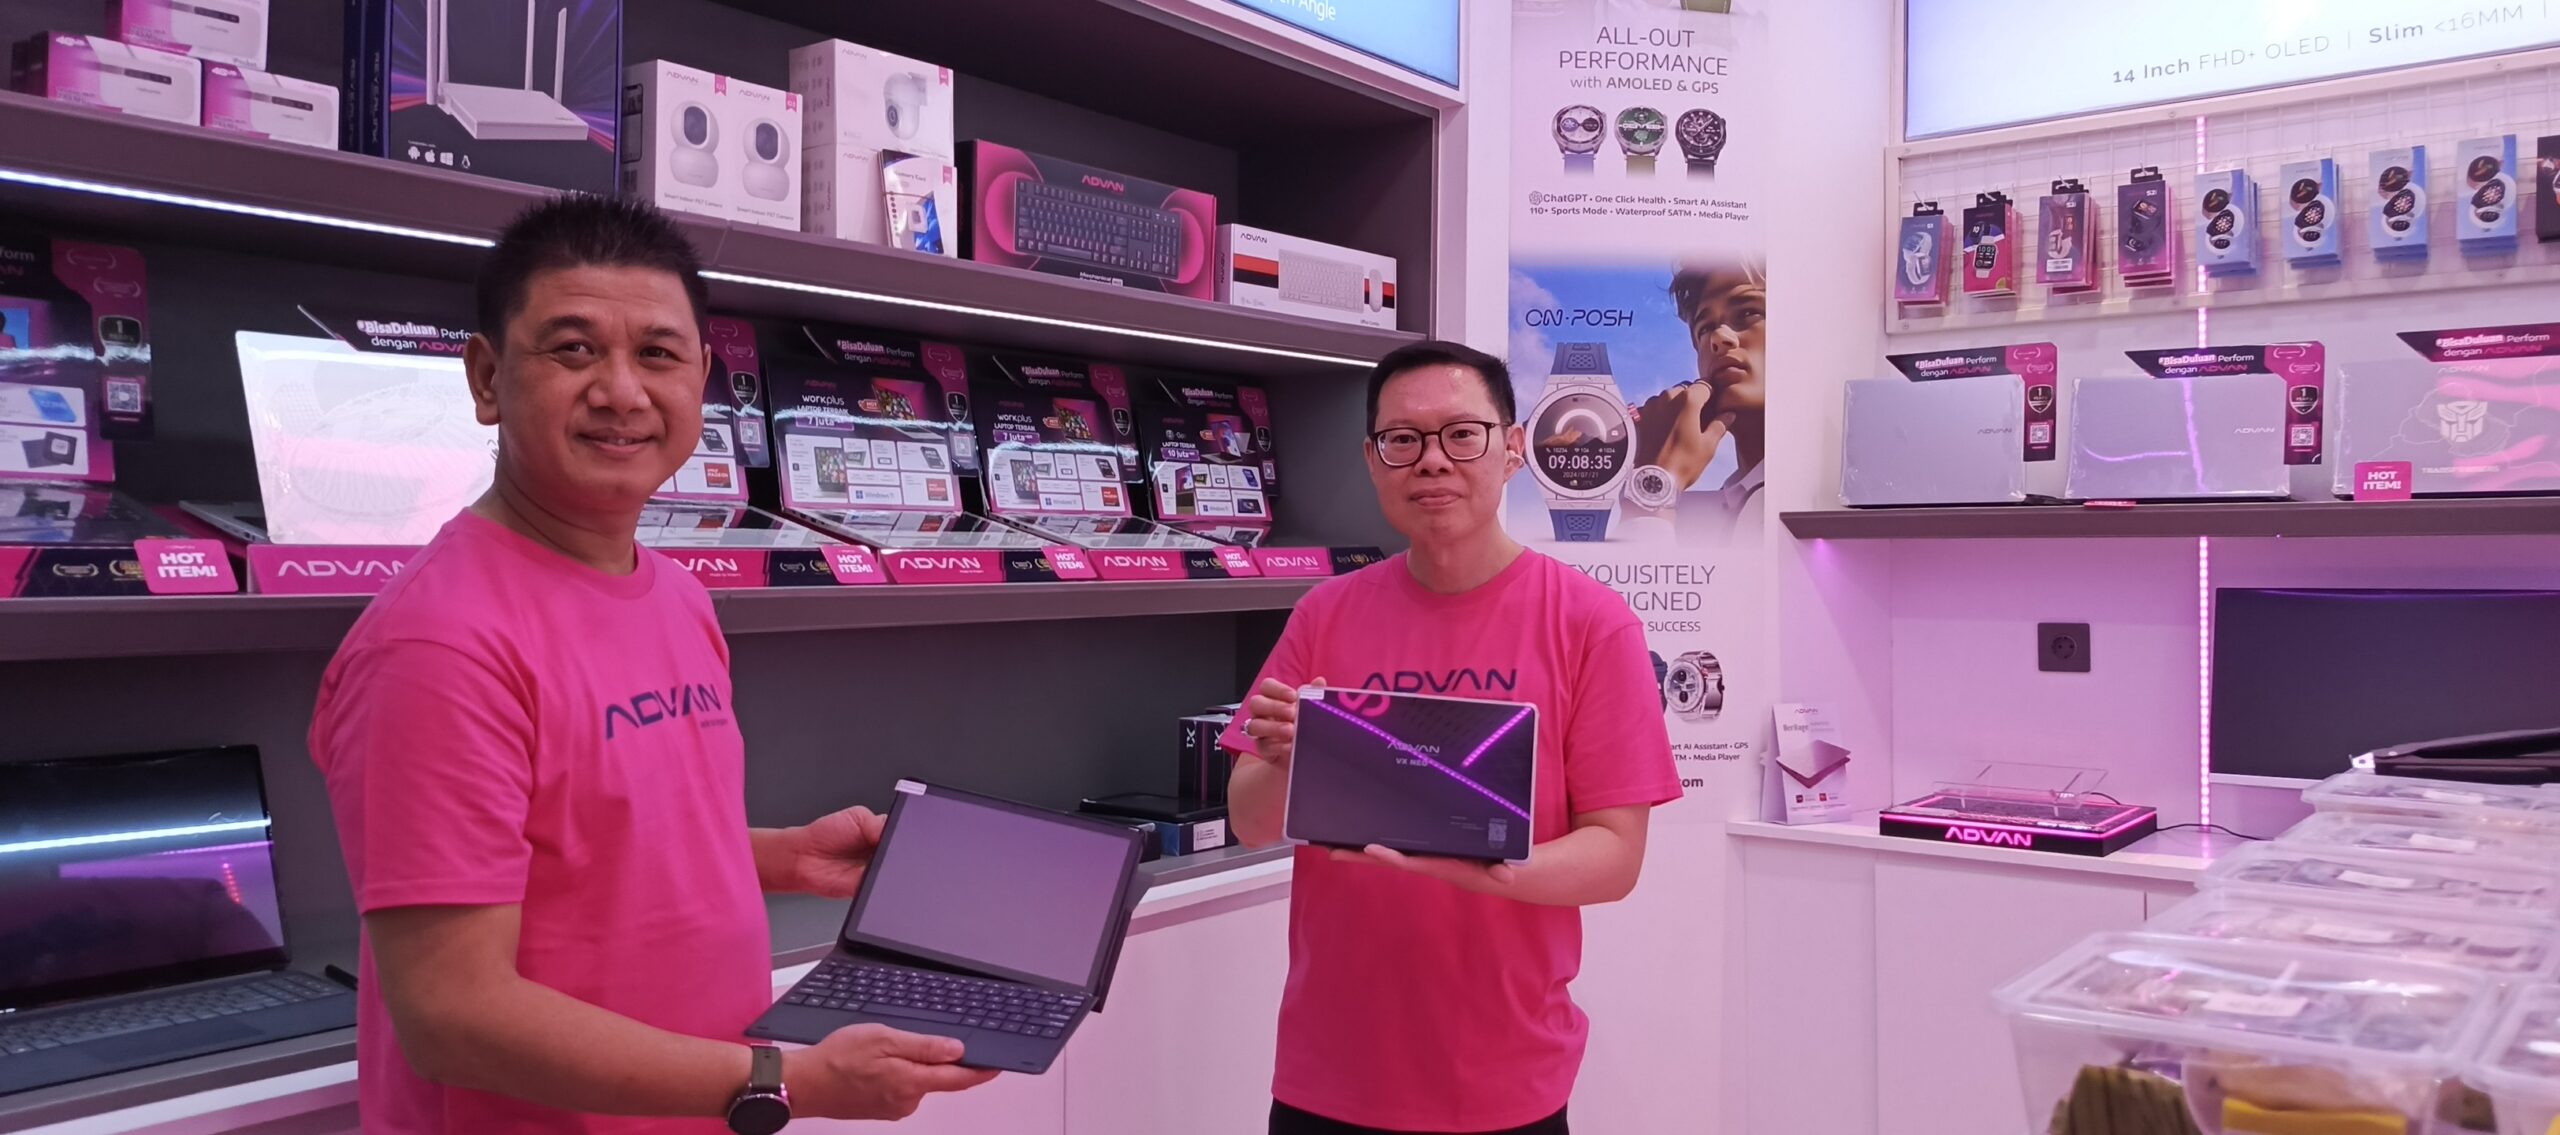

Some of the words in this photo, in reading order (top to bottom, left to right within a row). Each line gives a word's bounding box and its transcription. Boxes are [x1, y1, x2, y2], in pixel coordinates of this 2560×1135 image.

[1299, 0, 1336, 21] Angle
[1596, 26, 1695, 48] ALL-OUT
[2112, 69, 2136, 84] 14
[2143, 57, 2190, 79] Inch
[2199, 48, 2256, 70] FHD+
[2265, 35, 2330, 61] OLED
[2368, 22, 2424, 44] Slim
[1559, 50, 1729, 77] PERFORMANCE
[1570, 76, 1602, 89] with
[1606, 77, 1672, 91] AMOLED
[1676, 80, 1688, 92] &
[1691, 81, 1719, 94] GPS
[1081, 175, 1125, 193] ADVAN
[1543, 193, 1588, 203] ChatGPT
[1594, 195, 1613, 203] One
[1615, 195, 1636, 204] Click
[1638, 196, 1667, 204] Health
[1673, 197, 1698, 206] Smart
[1710, 199, 1747, 209] Assistant
[1551, 206, 1580, 216] Sports
[1582, 207, 1608, 215] Mode
[1615, 207, 1666, 217] Waterproof
[1698, 210, 1723, 219] Media
[1724, 212, 1750, 222] Player
[1240, 232, 1268, 244] ADVAN
[371, 336, 418, 350] dengan
[2505, 333, 2550, 344] Perform
[2217, 353, 2255, 363] Perform
[2443, 348, 2483, 358] dengan
[1965, 355, 1997, 365] Perform
[1920, 368, 1949, 378] dengan
[2164, 364, 2198, 375] dengan
[802, 395, 845, 406] workplus
[2233, 426, 2276, 434] ADVAN
[1548, 455, 1612, 469] 09:08:35
[2367, 471, 2398, 481] HOT
[2362, 481, 2402, 491] ITEM!
[159, 552, 206, 565] HOT
[836, 555, 863, 564] HOT
[1055, 553, 1077, 562] HOT
[1104, 556, 1168, 567] ADVAN
[1224, 552, 1242, 560] HOT
[1266, 556, 1318, 567] ADVAN
[672, 558, 739, 572] VAN
[900, 557, 981, 569] ADVAN
[1056, 561, 1085, 570] ITEM!
[157, 565, 219, 578] ITEM!
[838, 564, 874, 574] ITEM!
[1569, 564, 1716, 587] XQUISITELY
[1619, 591, 1702, 611] IGNED
[1647, 621, 1702, 632] SUCCESS
[1360, 667, 1518, 694] ADVAN
[605, 683, 722, 741] ADVAN
[1387, 741, 1440, 754] ADVAN
[1734, 742, 1749, 750] GPS
[1717, 753, 1741, 762] Player
[1679, 778, 1704, 788] om
[1944, 825, 2032, 848] ADVAN
